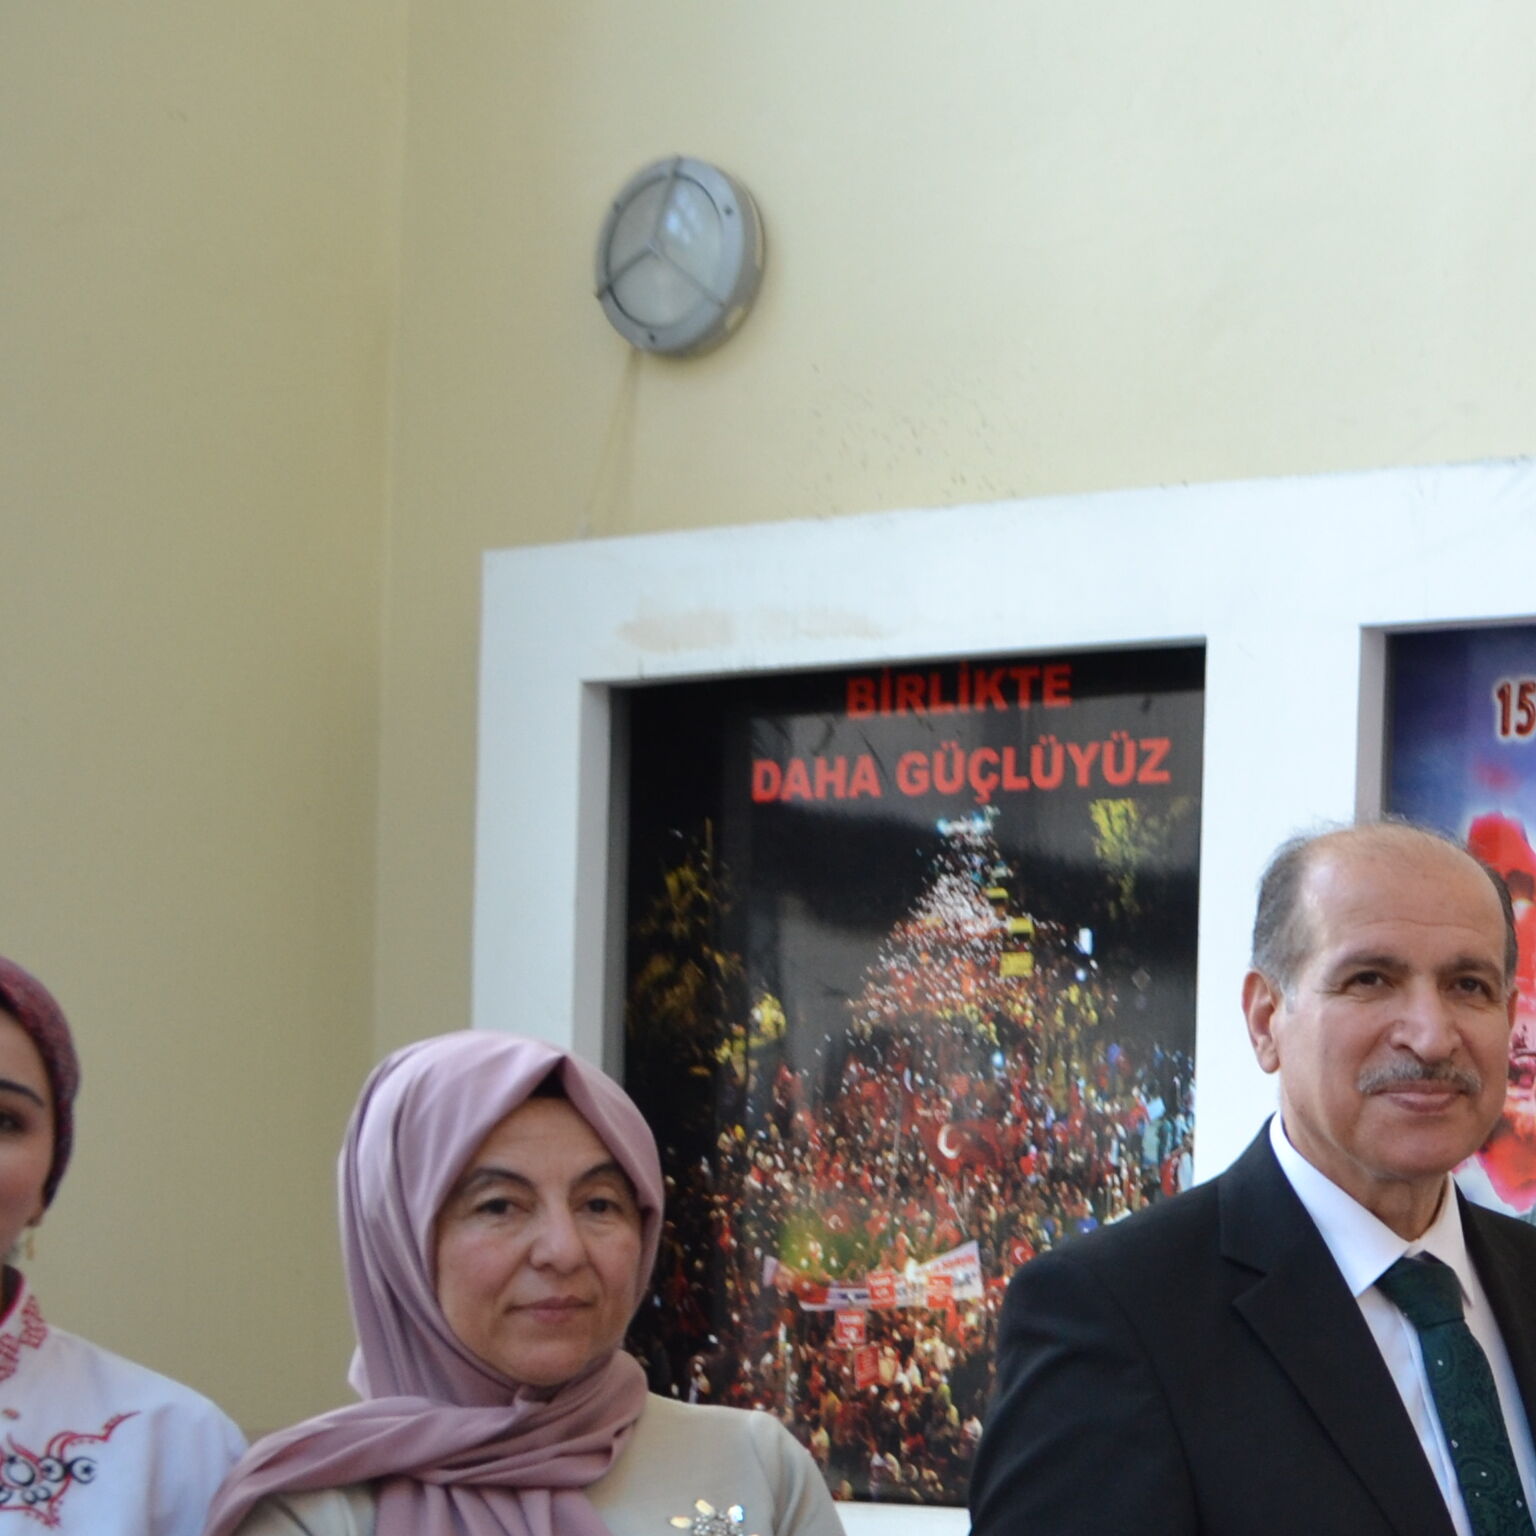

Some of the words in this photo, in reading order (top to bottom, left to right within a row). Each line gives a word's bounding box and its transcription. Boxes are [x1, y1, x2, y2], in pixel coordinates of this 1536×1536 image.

[845, 662, 1073, 719] BİRLİKTE
[1498, 681, 1536, 737] 15
[752, 755, 882, 803] DAHA
[897, 731, 1172, 805] GÜÇLÜYÜZ
